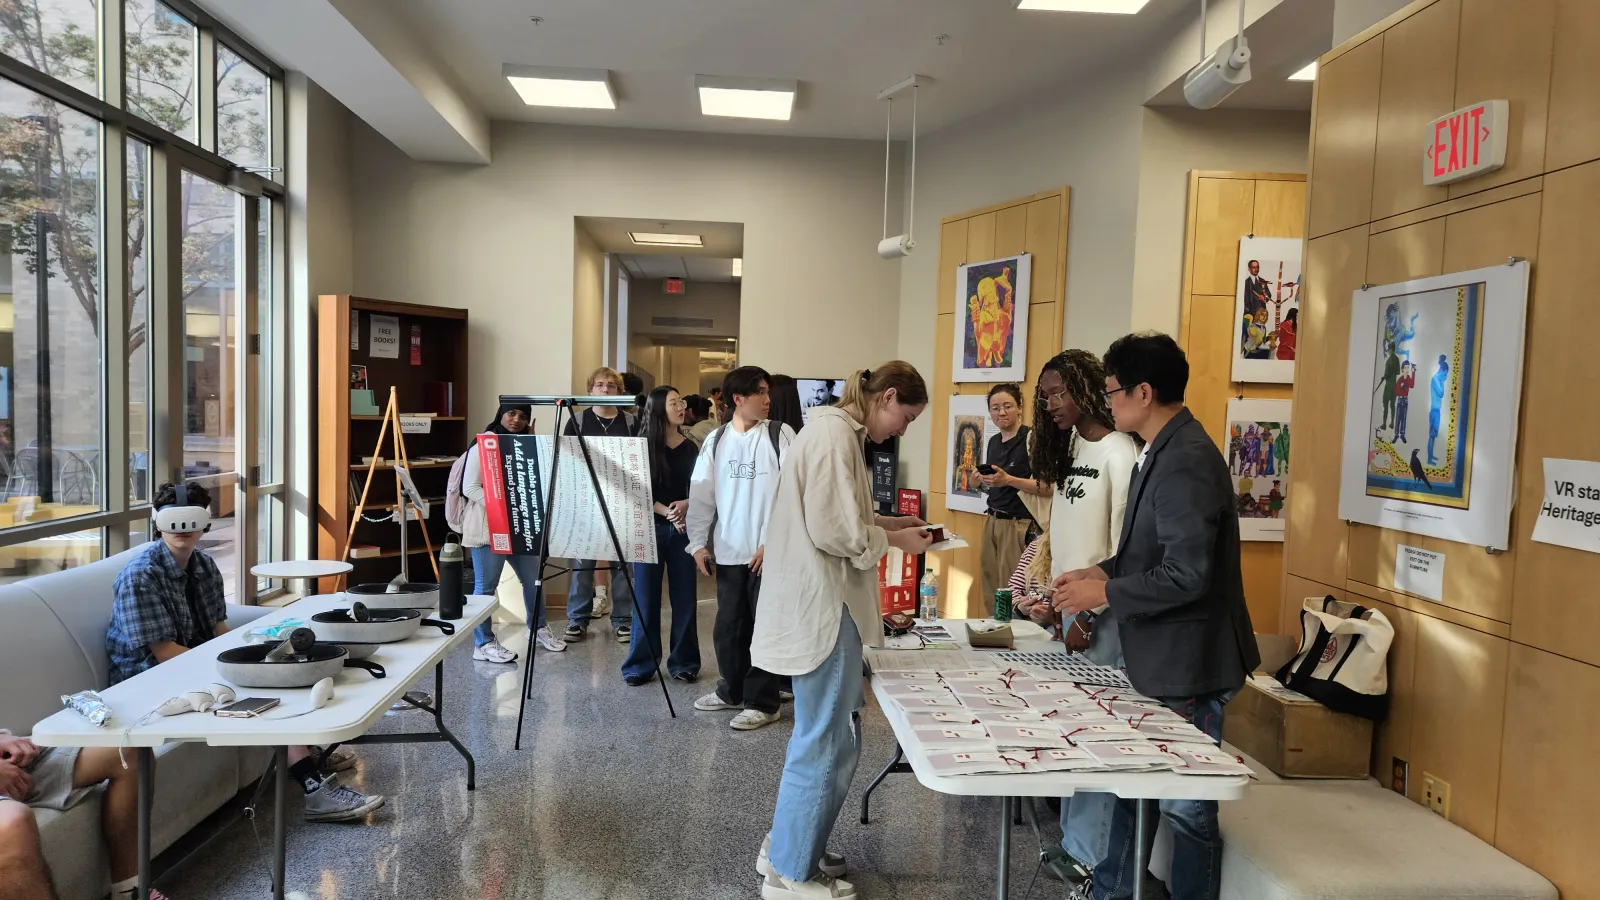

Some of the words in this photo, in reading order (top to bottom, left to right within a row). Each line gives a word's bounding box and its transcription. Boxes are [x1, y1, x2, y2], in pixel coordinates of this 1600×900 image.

[1434, 106, 1484, 178] EXIT
[513, 439, 524, 461] Add
[505, 454, 515, 486] Expand
[527, 458, 536, 488] Double
[507, 486, 517, 506] your
[517, 471, 529, 518] language
[528, 489, 538, 508] your
[1554, 480, 1574, 497] VR
[1578, 486, 1600, 501] sta
[512, 507, 520, 535] future.
[533, 510, 541, 535] value.
[522, 519, 534, 552] major.
